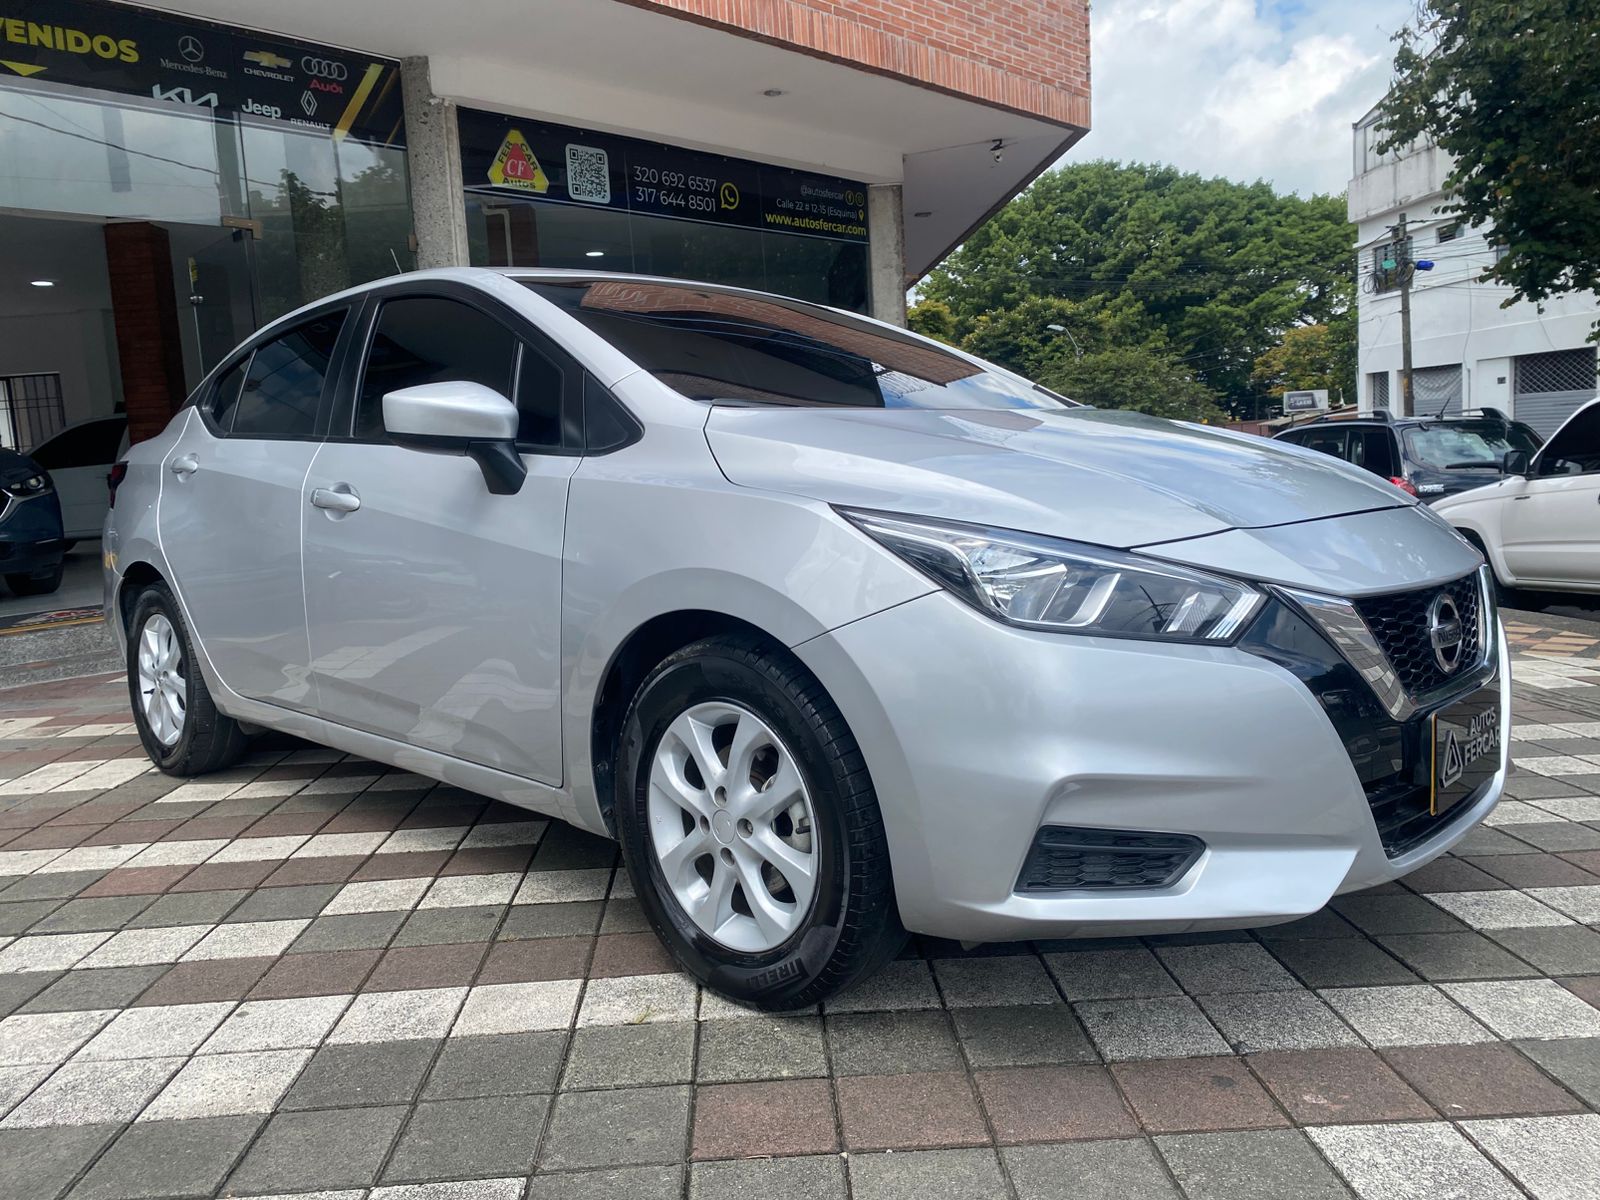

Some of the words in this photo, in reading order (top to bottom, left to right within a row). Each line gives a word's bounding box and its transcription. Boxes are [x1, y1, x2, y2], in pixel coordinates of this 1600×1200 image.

[0, 17, 139, 63] ENIDOS
[160, 57, 228, 79] Mercedes-Benz
[244, 67, 295, 83] CHEVROLET
[309, 79, 344, 94] Audi
[241, 98, 281, 120] Jeep
[290, 117, 332, 131] RENAULT
[498, 140, 513, 164] FER
[520, 142, 538, 171] CAR
[502, 177, 536, 189] Autos
[633, 165, 659, 184] 320
[661, 170, 685, 188] 692
[688, 175, 717, 193] 6537
[635, 186, 657, 203] 317
[660, 190, 686, 208] 644
[688, 195, 716, 213] 8501
[800, 184, 844, 200] @autosfercar
[776, 198, 794, 210] Calle
[795, 201, 804, 211] 22
[811, 203, 826, 215] 12-15
[827, 206, 858, 220] (Esquina)
[765, 212, 867, 236] www.autosfercar.com
[1470, 706, 1496, 737] AUTOS
[1464, 725, 1501, 767] FERCAR
